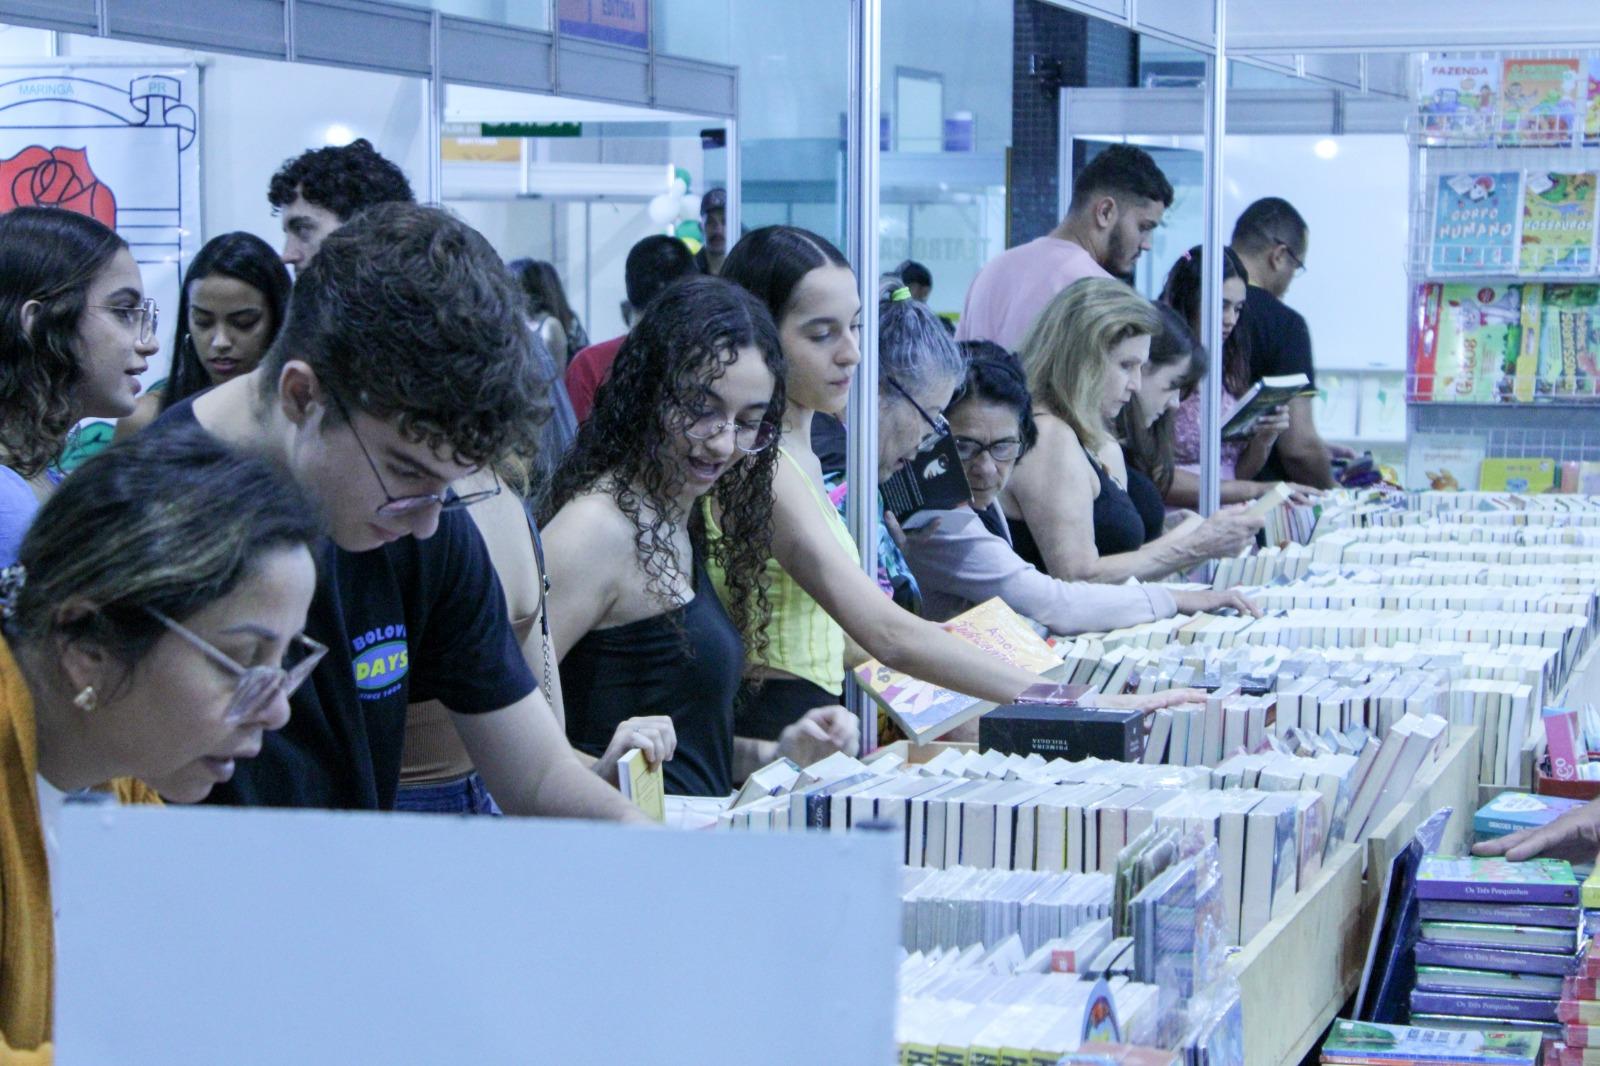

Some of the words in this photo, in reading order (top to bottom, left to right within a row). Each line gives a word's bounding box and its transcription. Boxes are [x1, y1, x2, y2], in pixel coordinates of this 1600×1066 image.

[1432, 66, 1488, 76] FAZENDA
[18, 82, 75, 96] MARINGÁ
[148, 81, 167, 94] PR
[1451, 207, 1499, 222] CORPO
[1439, 222, 1513, 240] HUMANO
[355, 650, 408, 680] DAYS
[1465, 886, 1475, 894] Os
[1491, 888, 1529, 896] Porquinhos
